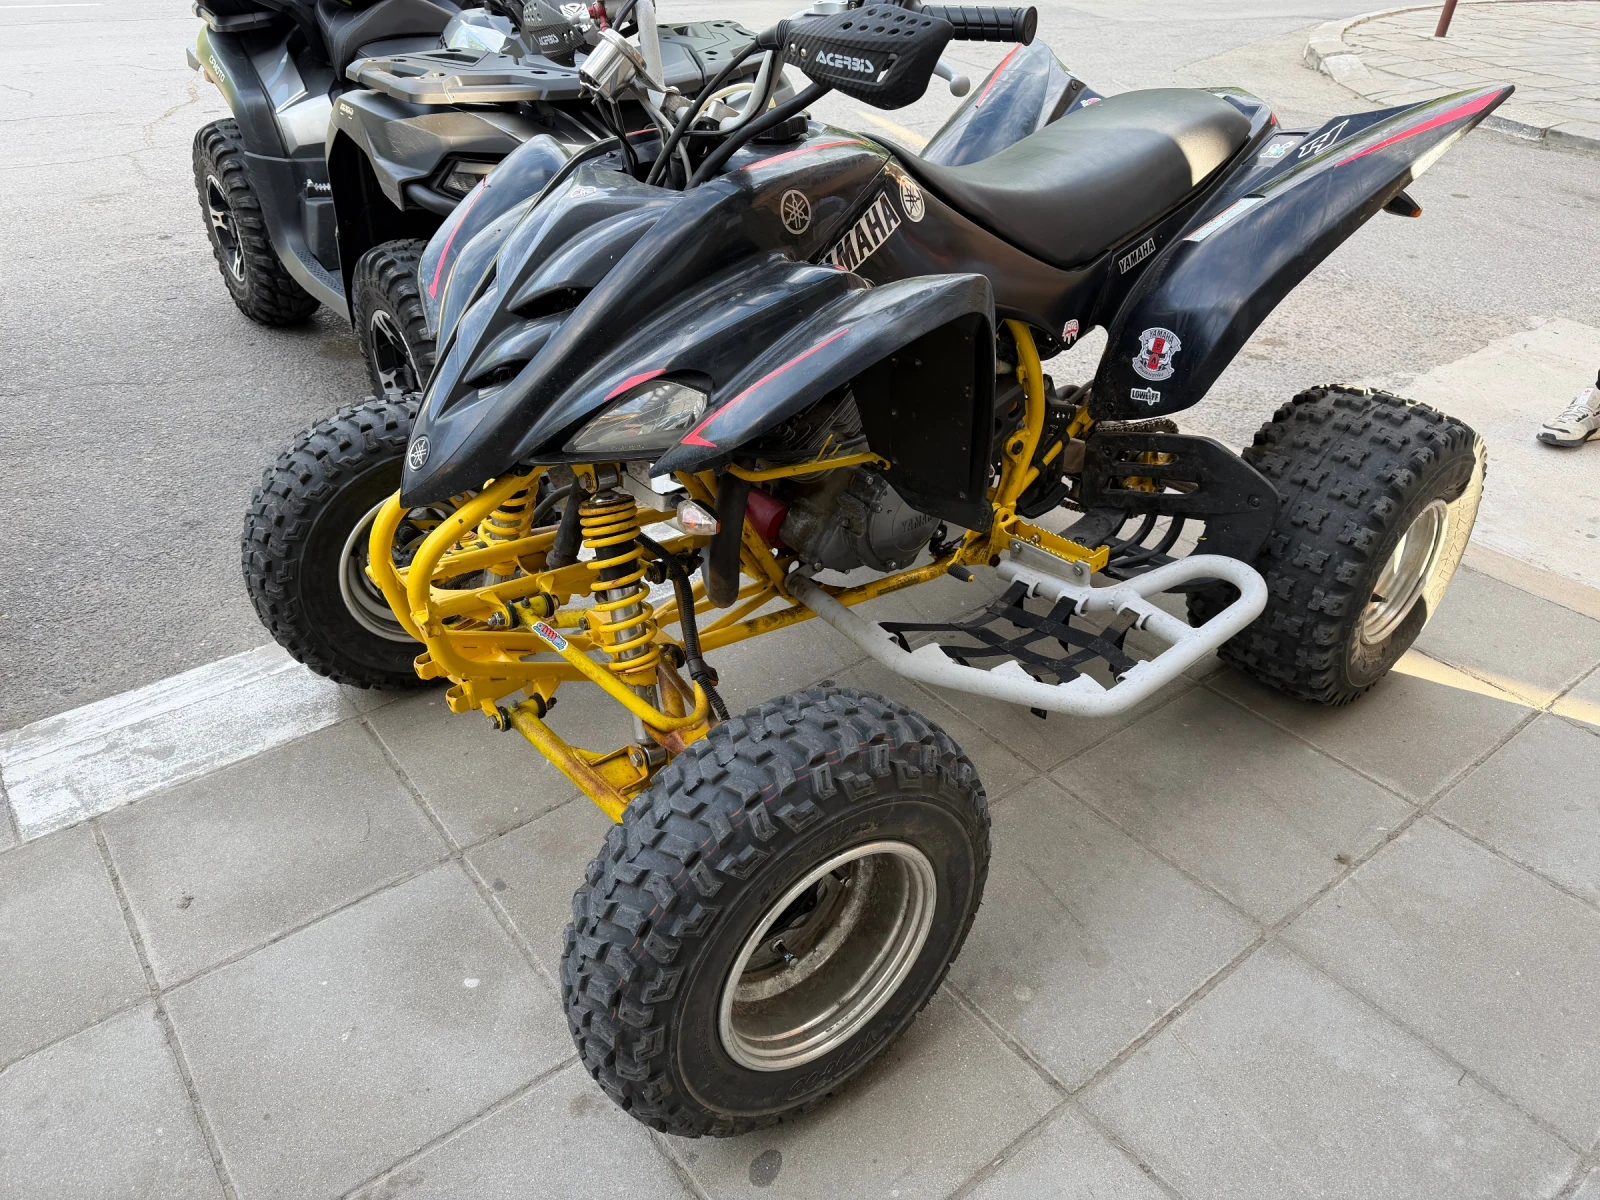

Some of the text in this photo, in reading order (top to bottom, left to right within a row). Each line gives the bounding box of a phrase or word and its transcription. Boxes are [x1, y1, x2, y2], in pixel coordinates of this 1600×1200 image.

[815, 50, 875, 74] ACERBIS
[818, 192, 901, 272] MAHA
[1119, 237, 1156, 274] YAMAHA
[1149, 329, 1174, 345] YAMAHA
